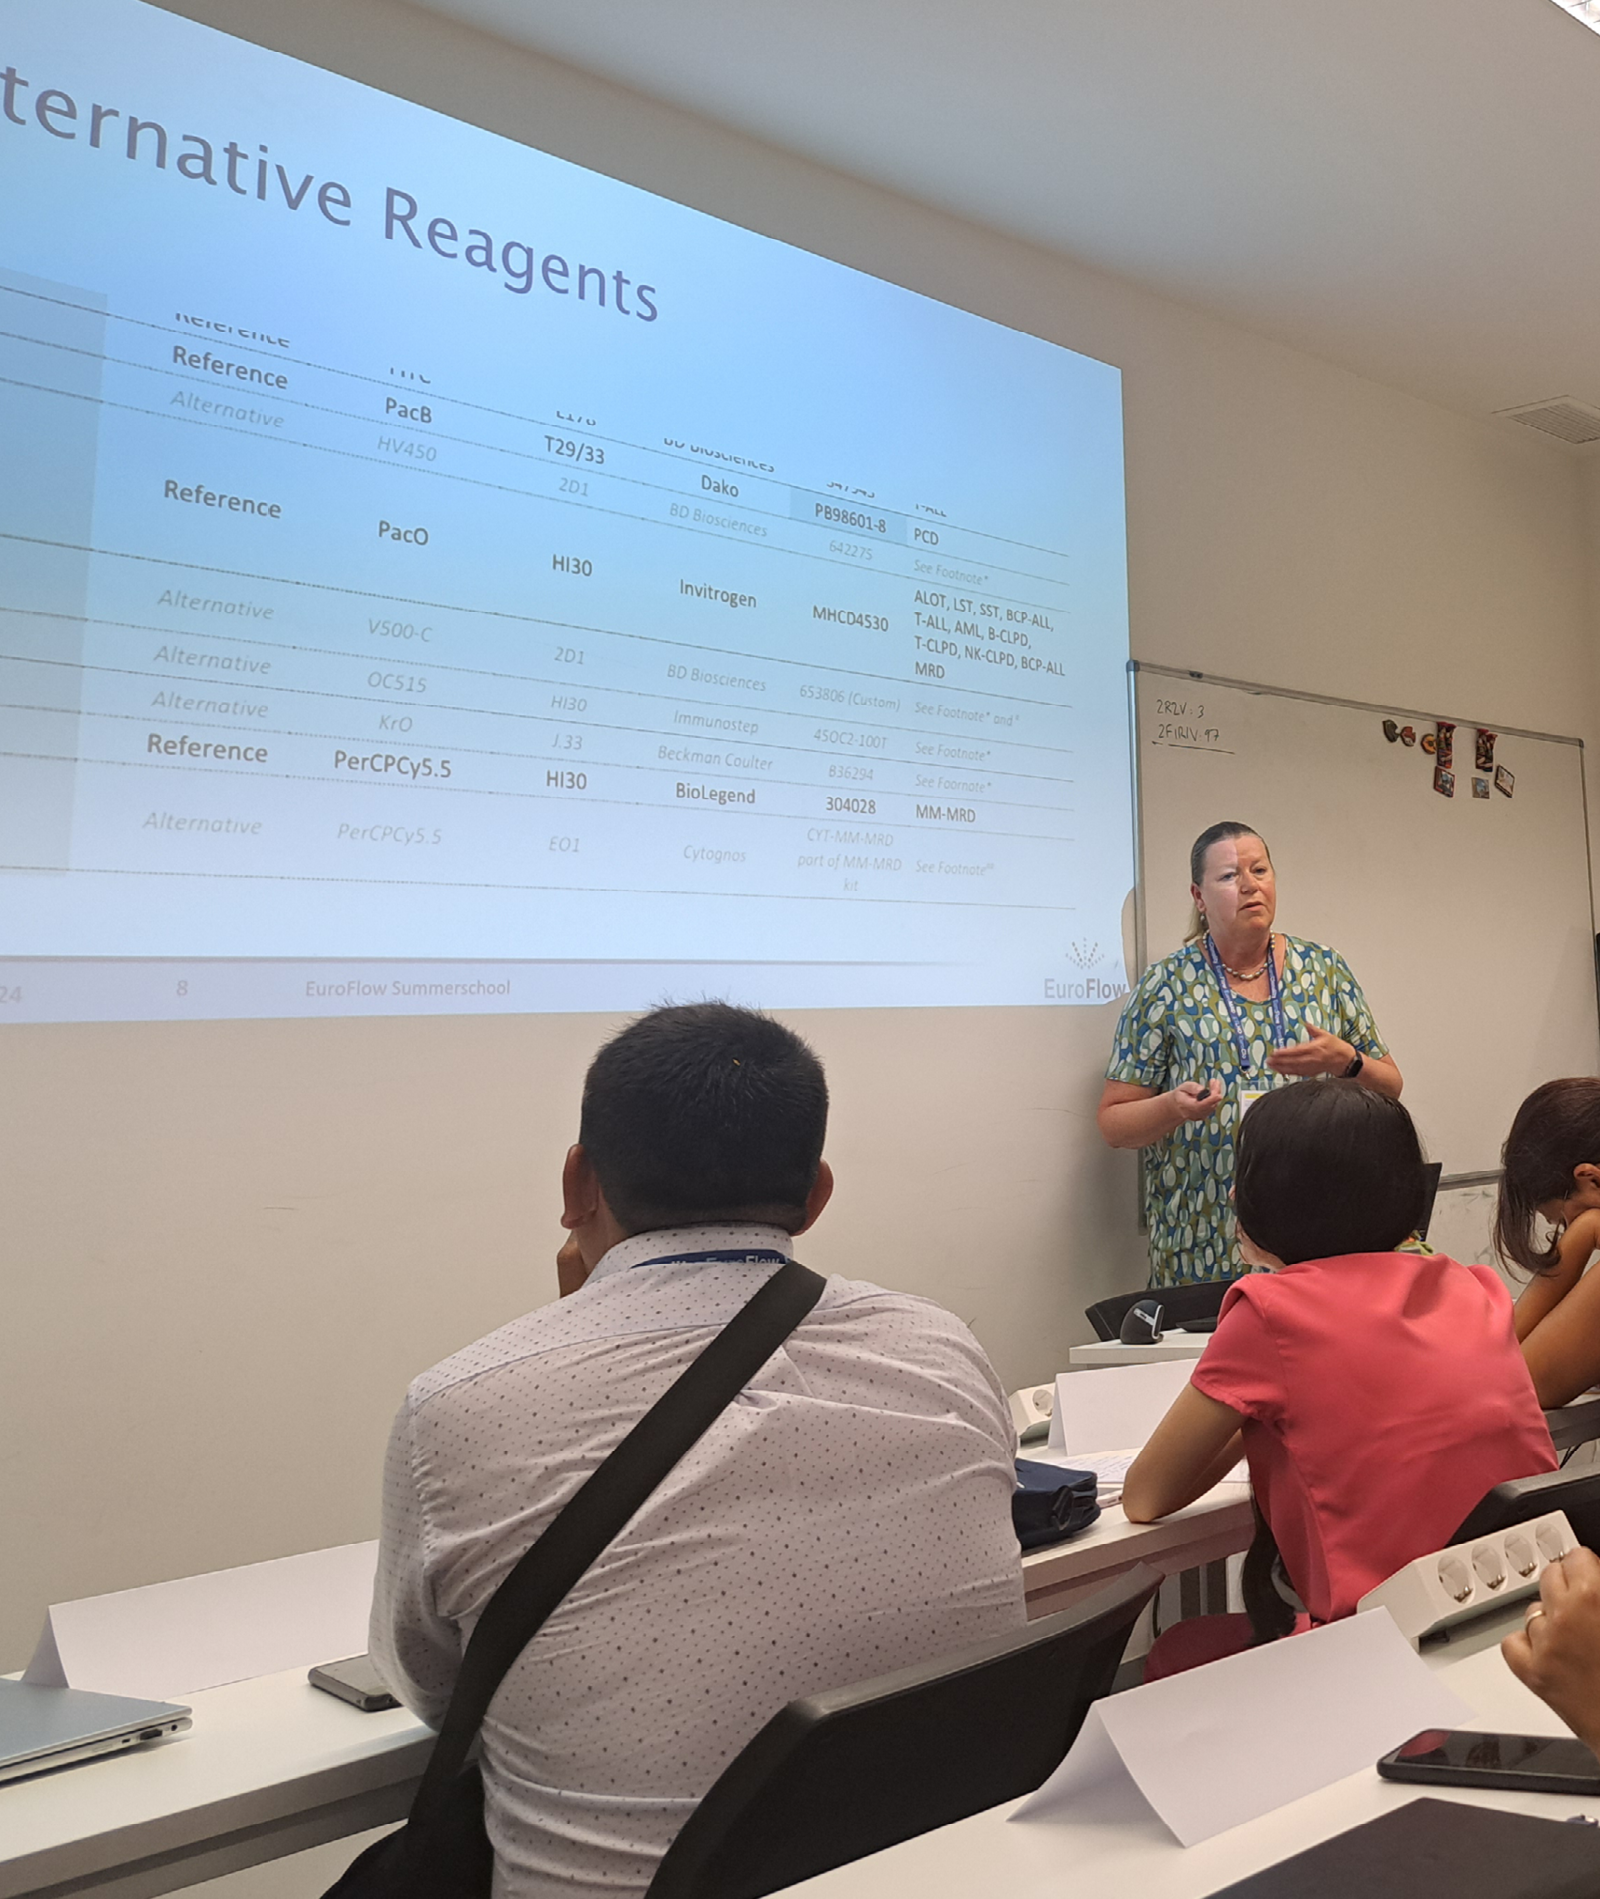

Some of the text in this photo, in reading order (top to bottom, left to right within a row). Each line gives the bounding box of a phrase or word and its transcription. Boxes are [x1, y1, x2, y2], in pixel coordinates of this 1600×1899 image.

[384, 187, 658, 322] Reagents
[173, 346, 288, 389] Reference
[171, 391, 284, 428] Alternative
[386, 397, 432, 424] PacB
[378, 435, 437, 462] HV450
[544, 435, 605, 465] T29/33
[559, 477, 589, 497] 2D1
[701, 475, 739, 498] Dako
[164, 480, 281, 518] Reference
[670, 503, 767, 538] BD Biosciences
[815, 503, 887, 534] PB98601-8
[378, 520, 429, 545] PacO
[914, 528, 939, 546] PCD
[830, 539, 873, 561] 642275
[914, 559, 932, 574] See
[159, 590, 274, 620] Alternative
[680, 579, 757, 609] Invitrogen
[813, 606, 889, 632] MHCD4530
[914, 590, 1054, 631] ALOT, LST, SST, BCP-ALL,
[369, 618, 433, 642] V500-C
[914, 612, 1031, 649] T-ALL, AML, B-CLPD,
[154, 645, 270, 675] Alternative
[554, 645, 585, 665] 2D1
[914, 636, 1065, 676] T-CLPD, NK-CLPD, BCP-ALL
[667, 664, 766, 693] BD Biosciences
[915, 661, 945, 679] MRD
[152, 691, 268, 718] Alternative
[800, 684, 900, 712] 653806 (Custom)
[915, 702, 934, 715] See
[673, 710, 758, 736] Immunostep
[147, 733, 267, 763] Reference
[552, 733, 583, 751] J.33
[915, 742, 934, 755] See
[334, 750, 451, 782] PerCPCy5.5
[658, 746, 773, 770] Beckman Coulter
[829, 765, 874, 782] B36294
[915, 775, 934, 788] See
[676, 782, 755, 805] BioLegend
[826, 797, 876, 815] 304028
[916, 804, 976, 823] MM-MRD
[143, 812, 262, 836] Alternative
[338, 822, 442, 847] PerCPCy5.5
[807, 828, 893, 846] CYT-MM-MRD
[684, 845, 746, 863] Cytognos
[798, 854, 902, 871] part of MM-MRD
[916, 860, 934, 873] See
[843, 878, 858, 891] kit
[177, 980, 187, 997] 8
[305, 978, 511, 998] EuroFlow Summerschool
[1044, 978, 1126, 999] EuroFlow
